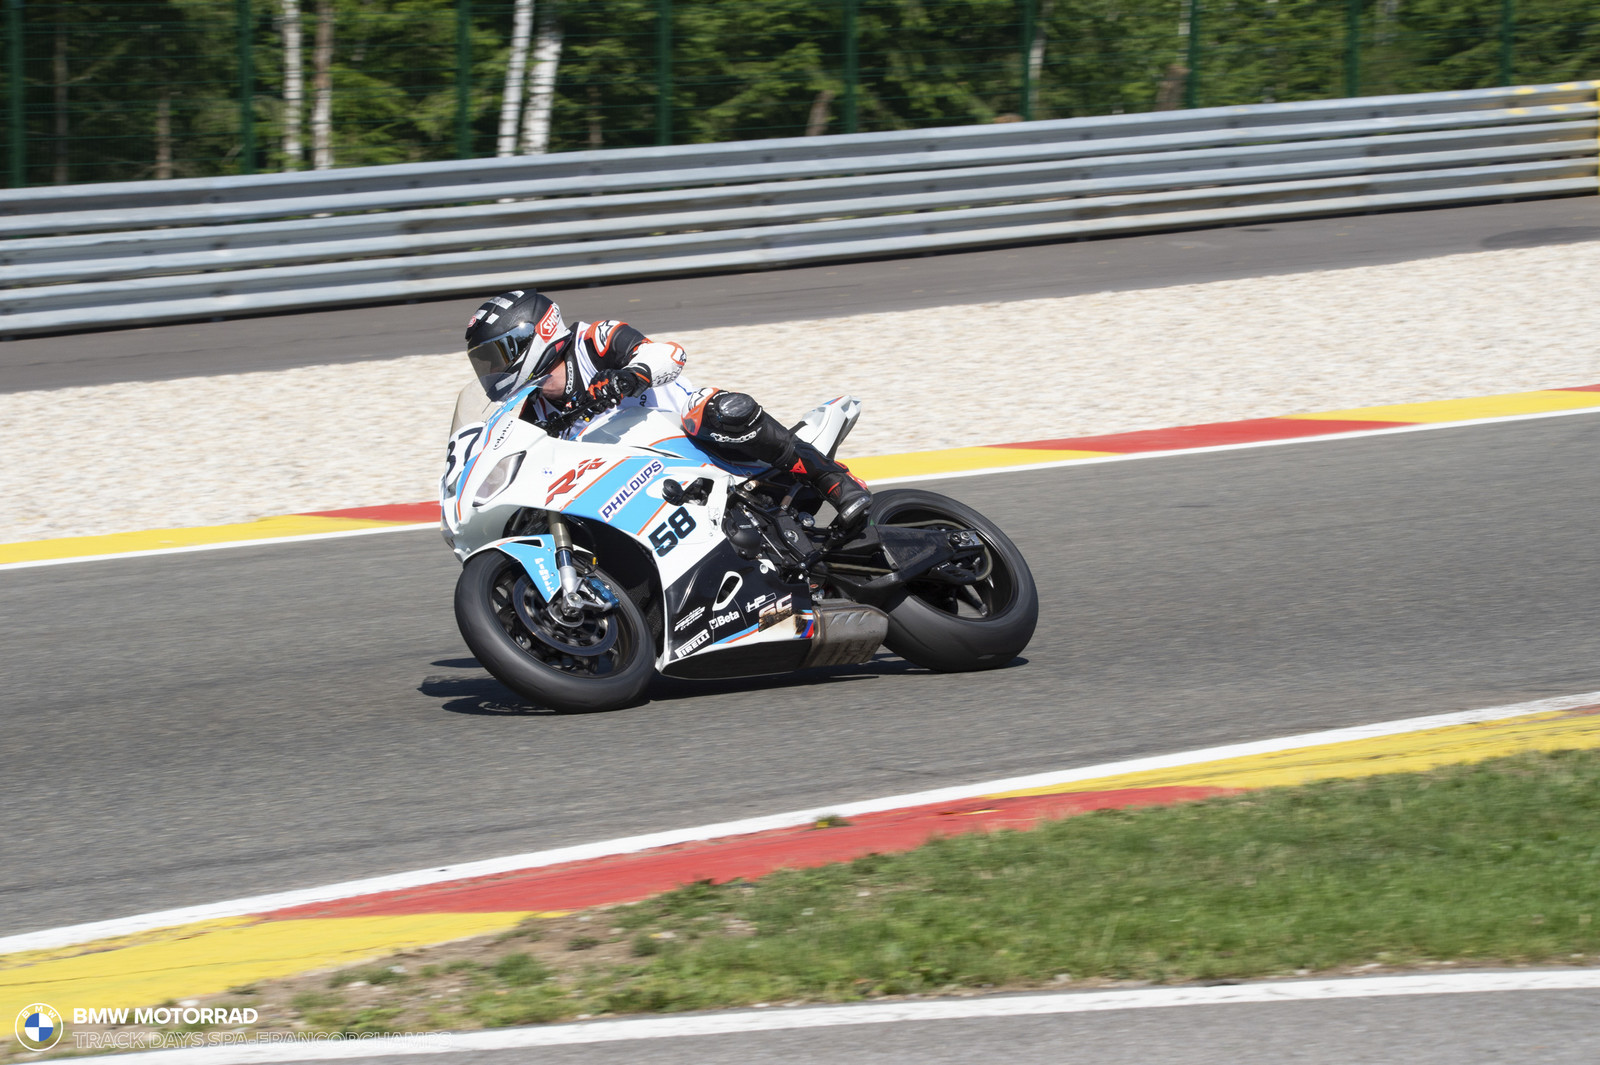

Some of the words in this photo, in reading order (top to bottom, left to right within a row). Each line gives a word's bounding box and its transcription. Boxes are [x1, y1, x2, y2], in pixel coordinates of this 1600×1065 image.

[602, 461, 662, 518] PHILOUPS
[648, 506, 697, 557] 58
[717, 611, 740, 626] Beta
[674, 629, 711, 659] PIRELLI
